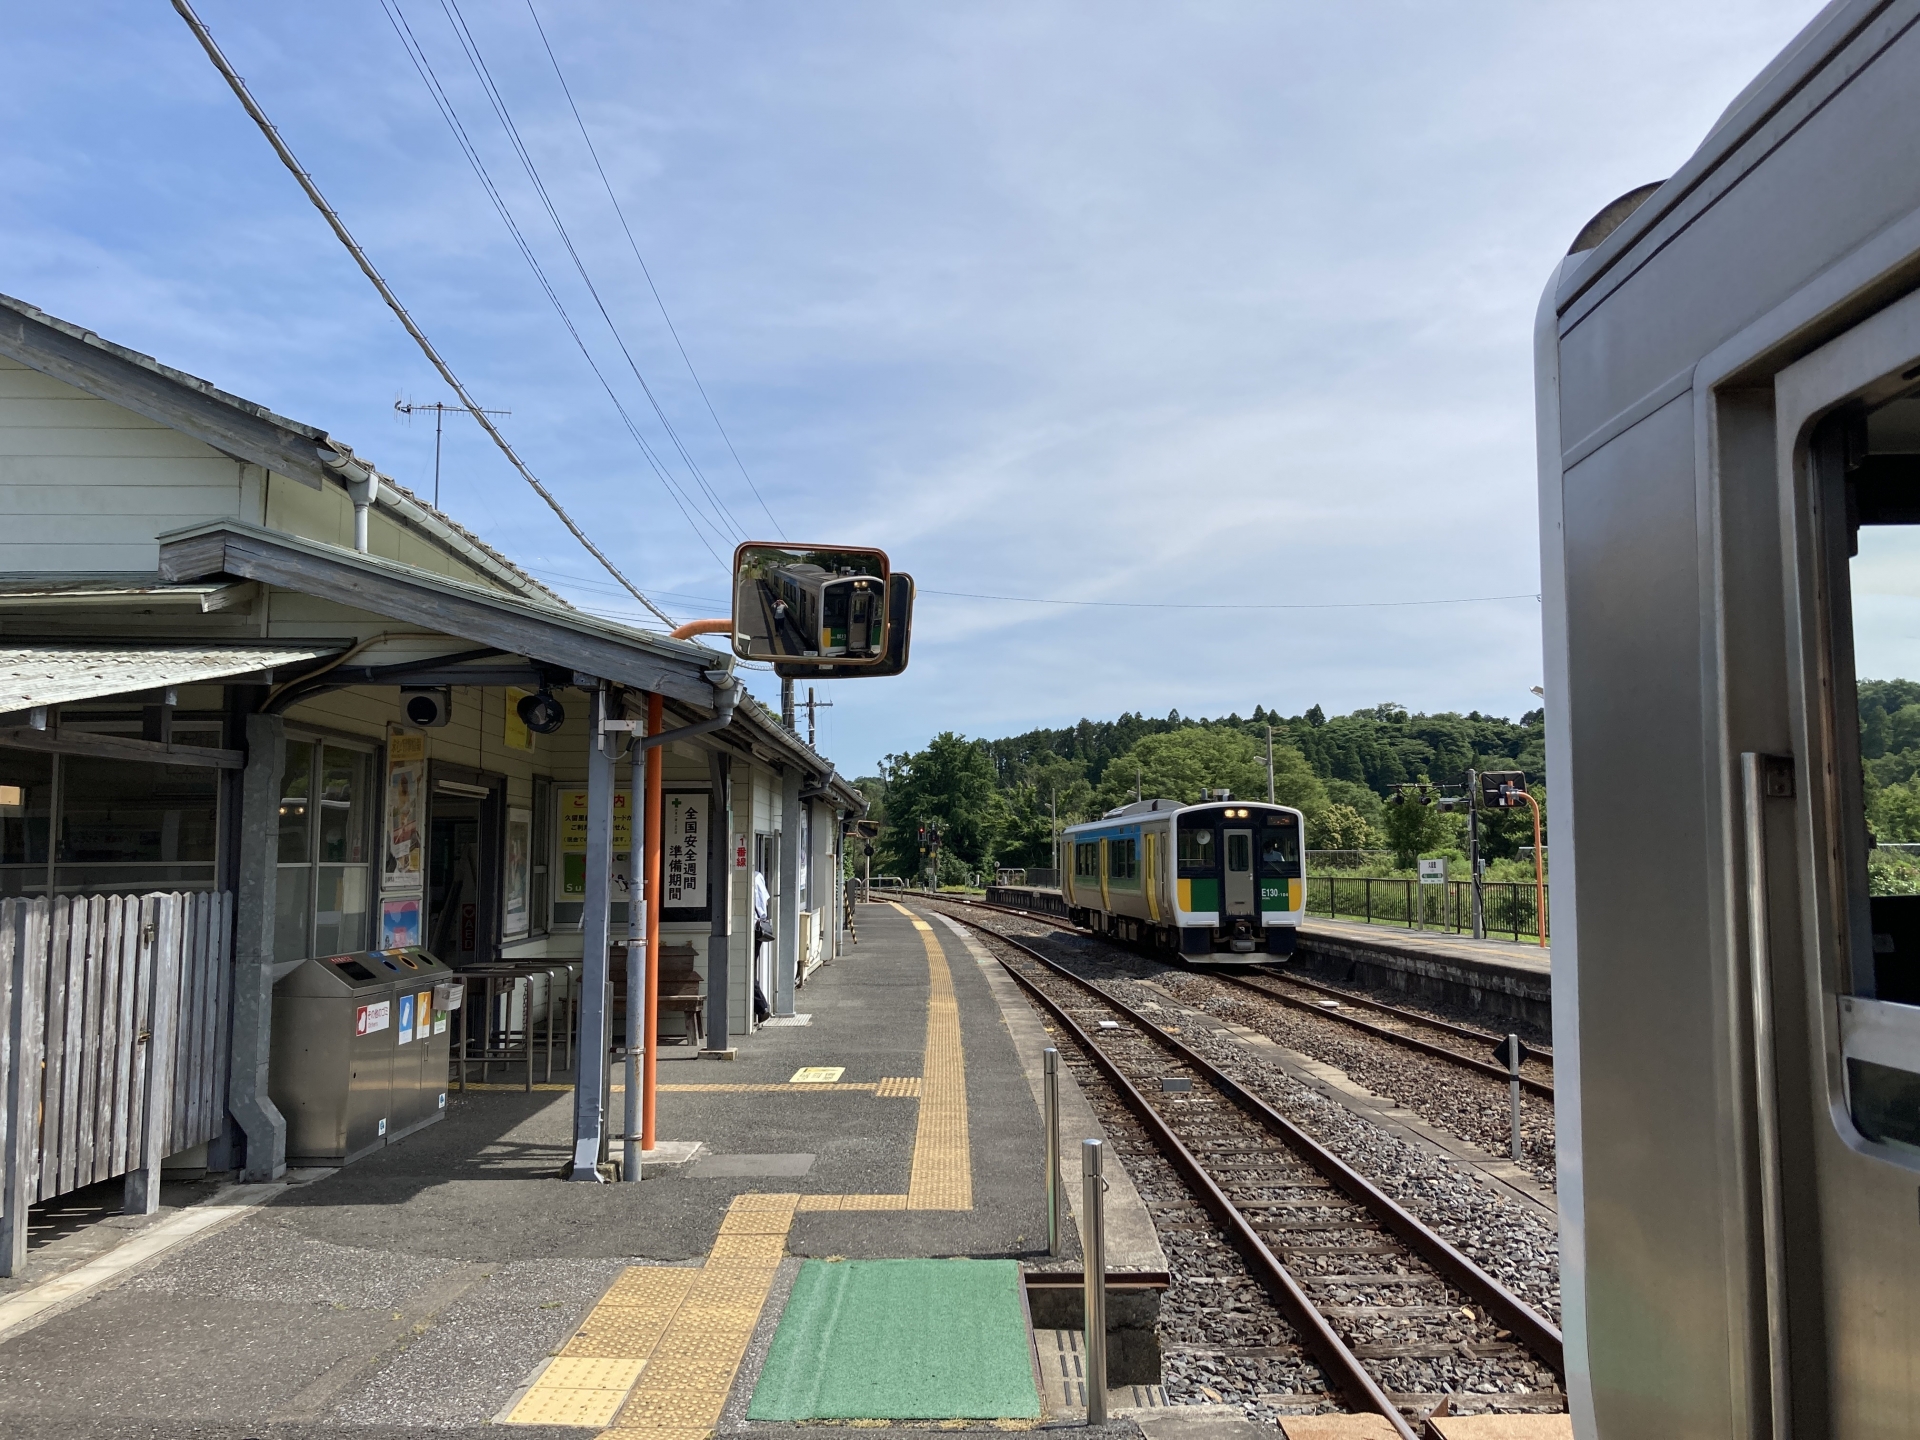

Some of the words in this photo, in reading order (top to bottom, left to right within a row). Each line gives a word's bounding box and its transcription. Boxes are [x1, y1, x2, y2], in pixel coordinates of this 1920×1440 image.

[573, 794, 626, 809] ご内
[683, 806, 698, 890] 全国安全週間
[736, 837, 747, 868] 1番線
[668, 845, 683, 901] 準備期間
[464, 919, 474, 949] AED
